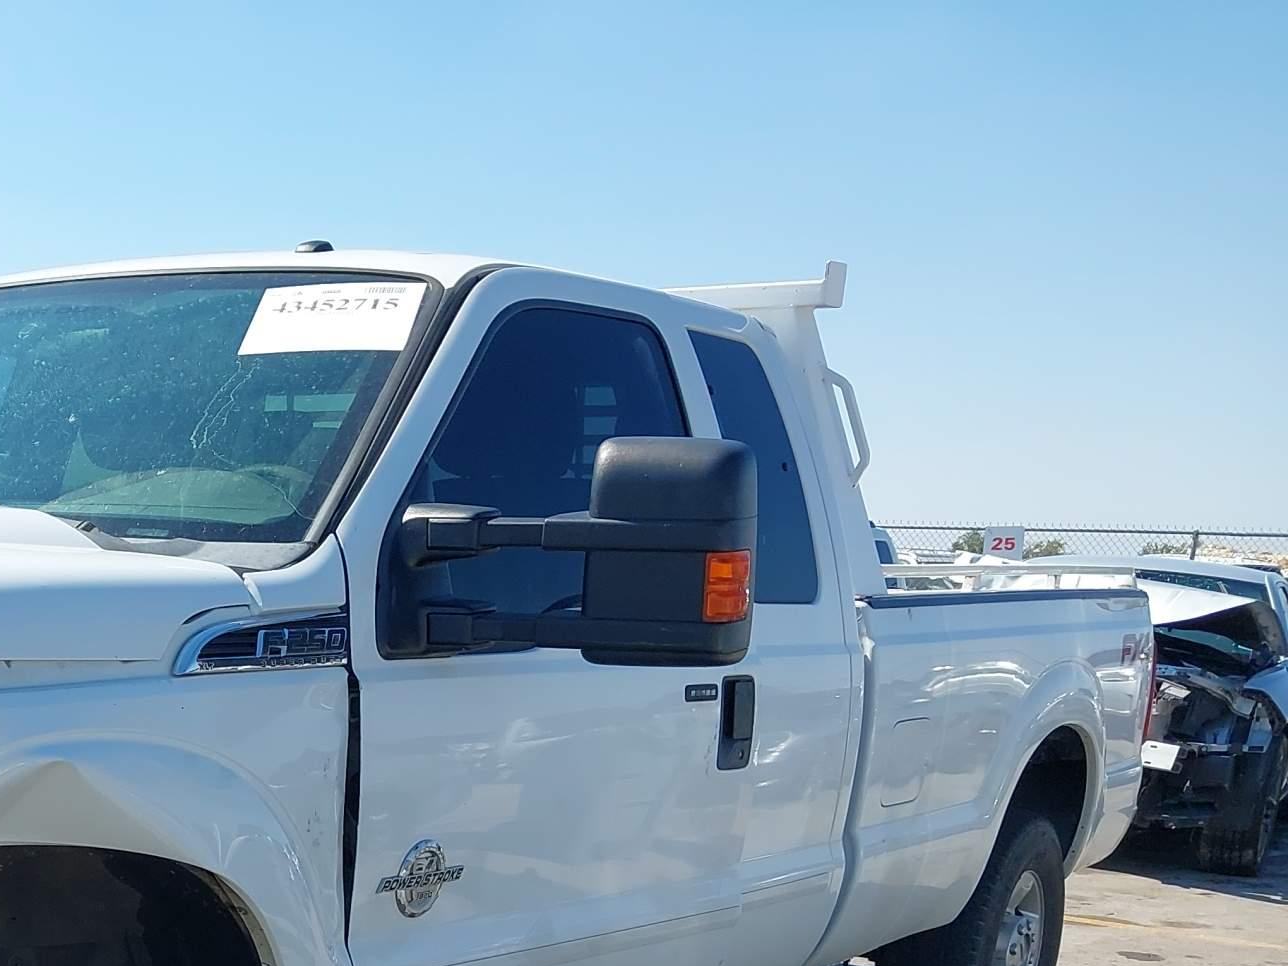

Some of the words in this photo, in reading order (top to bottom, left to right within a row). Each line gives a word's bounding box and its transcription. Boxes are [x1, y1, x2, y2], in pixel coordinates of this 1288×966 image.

[272, 298, 400, 313] 43452715
[991, 537, 1016, 551] 25
[381, 875, 423, 892] POWER
[423, 867, 464, 886] STROKE
